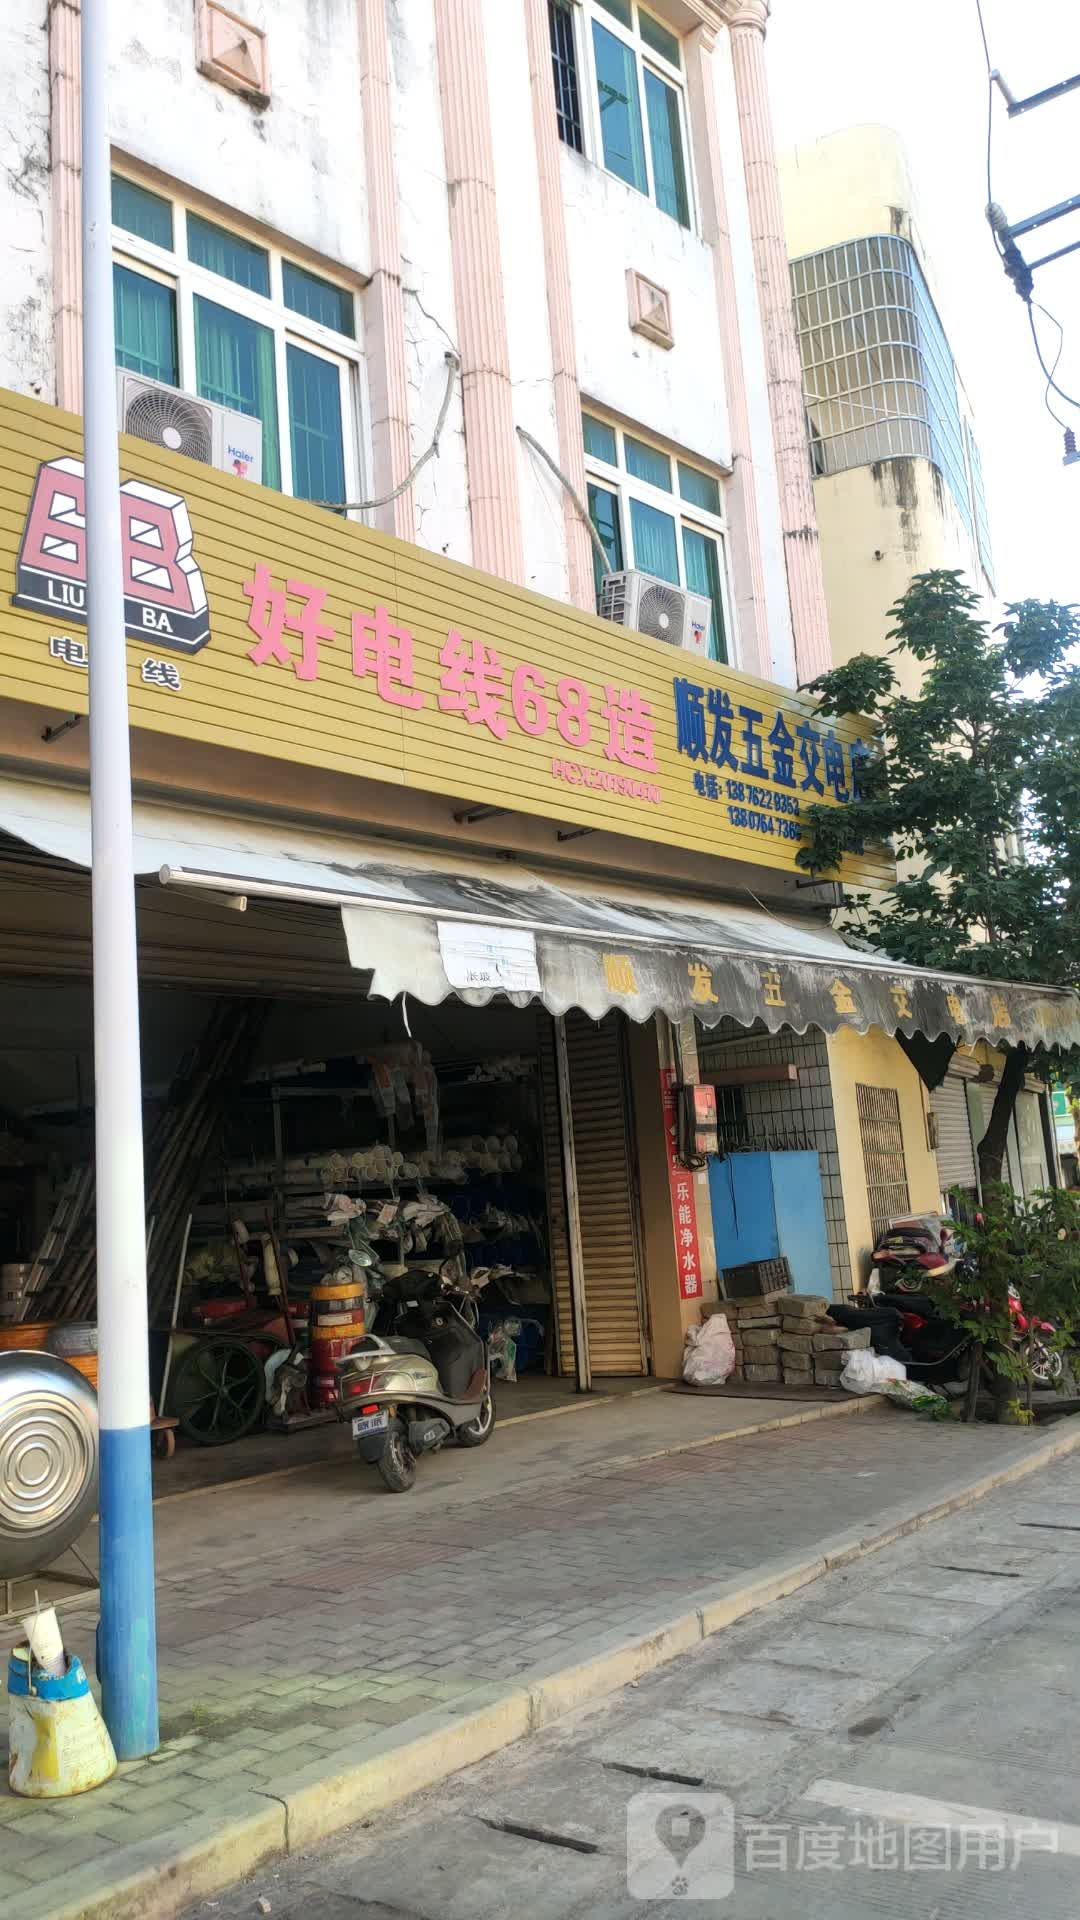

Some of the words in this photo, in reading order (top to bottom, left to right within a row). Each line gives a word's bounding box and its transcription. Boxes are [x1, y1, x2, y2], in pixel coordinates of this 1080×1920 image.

[227, 444, 253, 463] Haier
[48, 579, 84, 607] LIU
[142, 607, 173, 633] BA
[243, 562, 658, 774] 好电线68造
[676, 1182, 699, 1294] 乐能净水器
